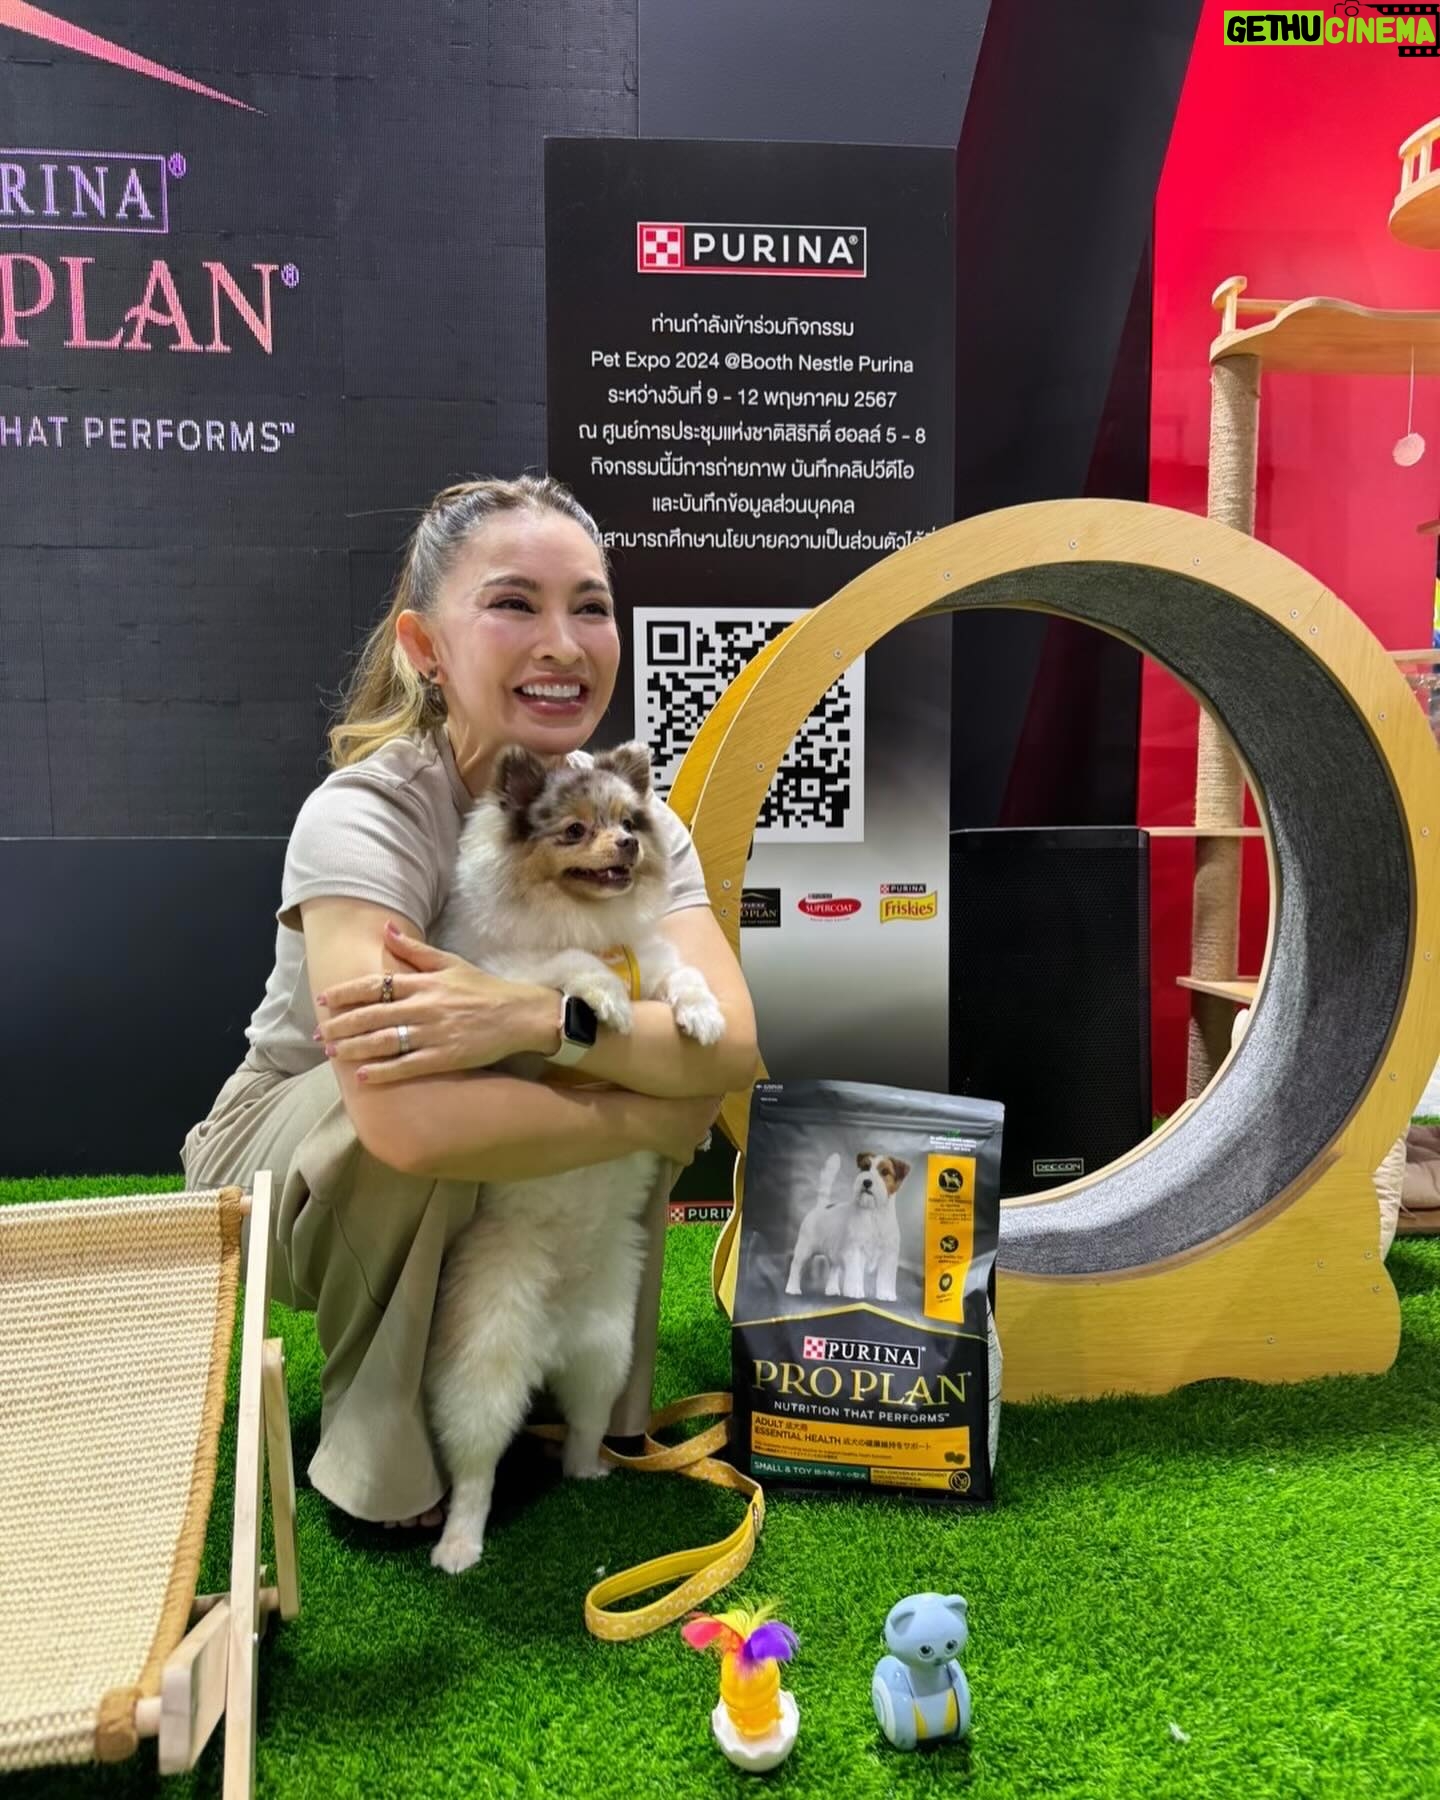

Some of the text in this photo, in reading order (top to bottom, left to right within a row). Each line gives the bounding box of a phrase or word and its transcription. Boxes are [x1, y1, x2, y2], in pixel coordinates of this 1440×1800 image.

[591, 350, 914, 374] Pet Expo 2024 @Booth Nestle Purina
[607, 379, 702, 405] ระหว่างวันที่
[706, 388, 719, 405] 9
[737, 388, 759, 406] 12
[763, 390, 850, 411] พฤษภาคม
[854, 390, 898, 409] 2567
[578, 423, 598, 440] ณ
[834, 425, 881, 444] ฮอลล์
[885, 427, 897, 444] 5
[914, 427, 927, 445] 8
[805, 903, 854, 913] SUPERCOAT
[885, 900, 934, 917] Friskies
[828, 1341, 916, 1366] PURINA
[751, 1359, 843, 1398] PRO
[773, 1400, 840, 1416] NUTRITION
[843, 1407, 875, 1419] THAT
[754, 1416, 783, 1428] ADULT
[754, 1426, 802, 1441] ESSENTIAL
[804, 1432, 842, 1445] HEALTH
[754, 1460, 783, 1473] SMALL
[793, 1465, 812, 1475] TOY
